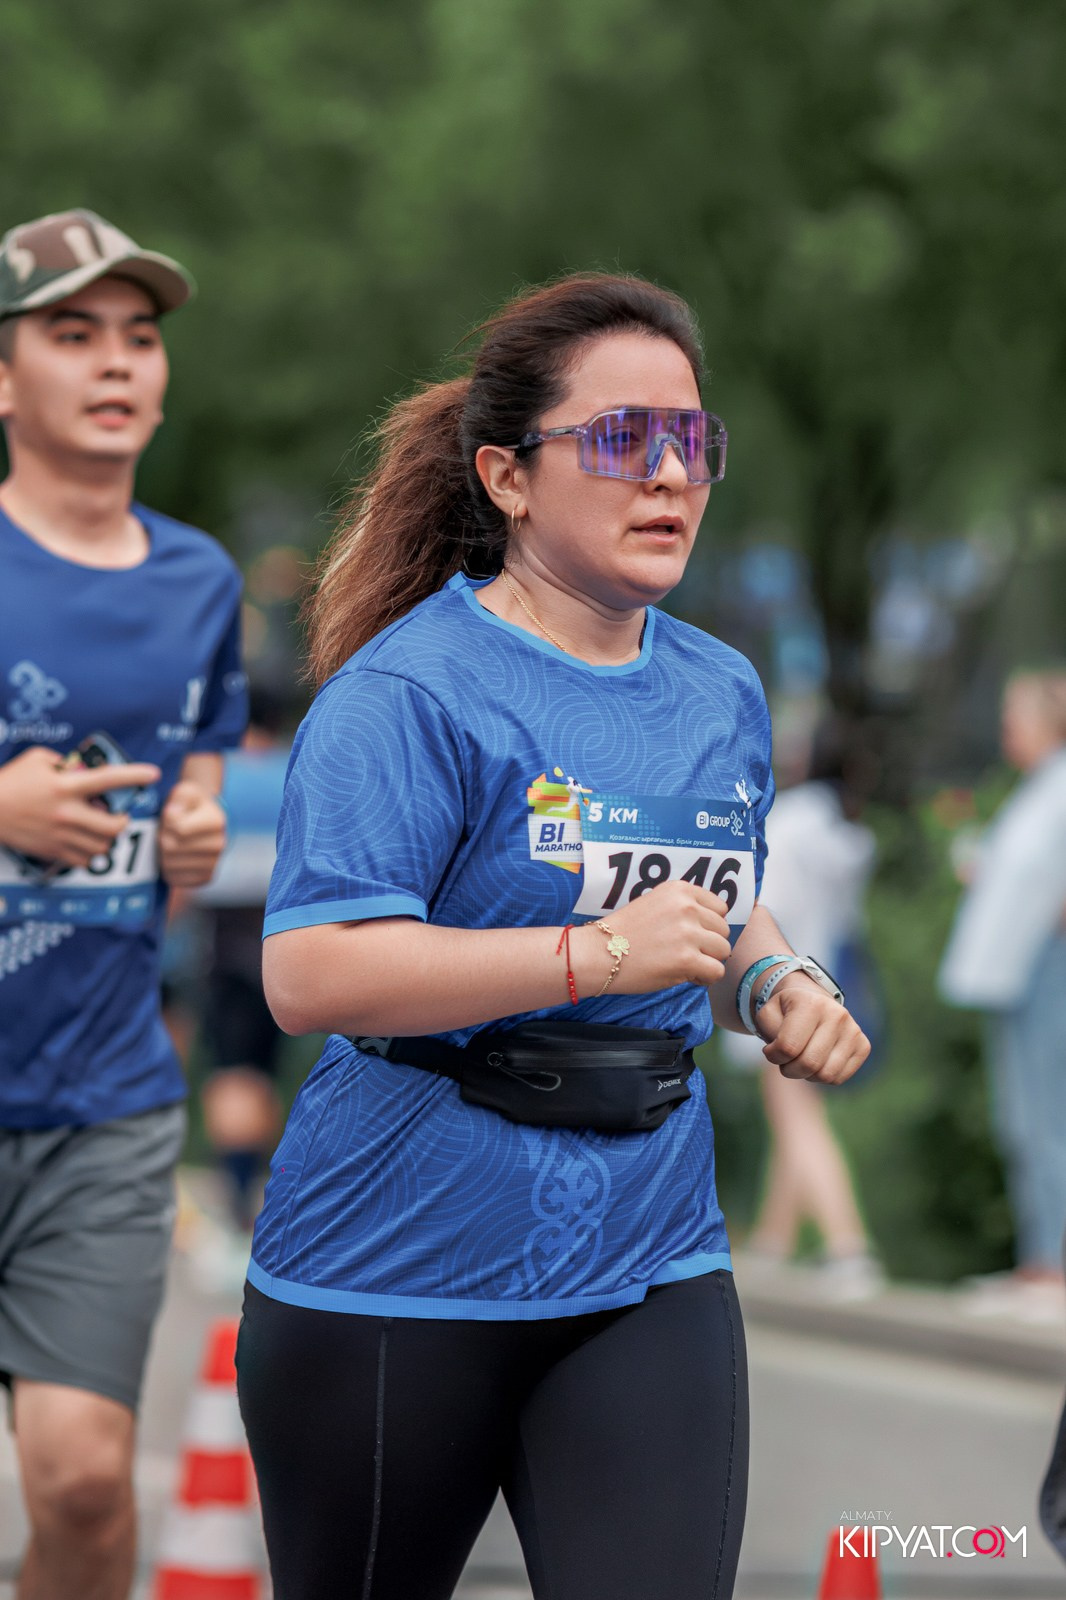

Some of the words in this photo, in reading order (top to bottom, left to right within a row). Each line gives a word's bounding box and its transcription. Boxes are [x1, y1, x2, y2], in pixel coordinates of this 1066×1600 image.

[587, 802, 603, 823] 5
[609, 807, 638, 824] KM
[710, 815, 731, 827] GROUP
[539, 822, 565, 843] BI
